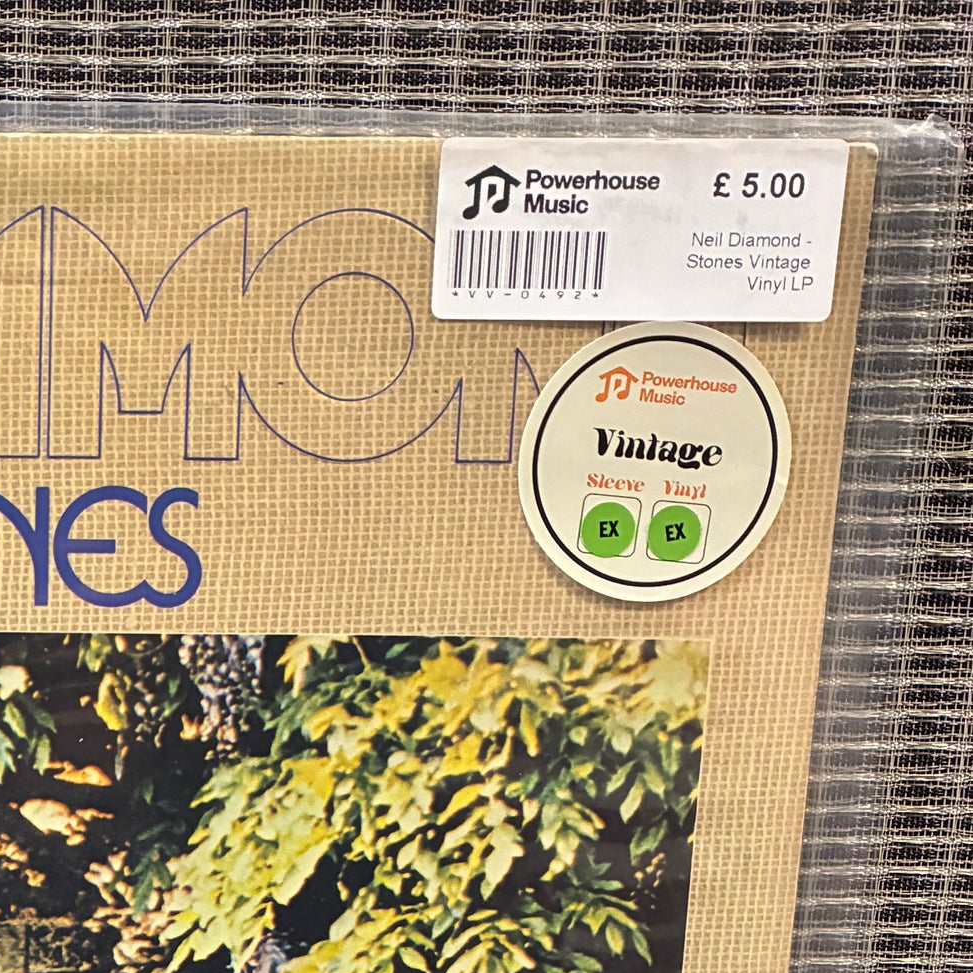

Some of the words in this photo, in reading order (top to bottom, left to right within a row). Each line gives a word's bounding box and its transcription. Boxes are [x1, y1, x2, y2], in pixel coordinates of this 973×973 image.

[525, 168, 661, 191] Powerhouse
[712, 172, 731, 199] £
[741, 172, 806, 199] 5.00
[523, 193, 589, 215] Music
[691, 231, 723, 247] Neil
[728, 231, 802, 248] Diamond
[686, 253, 743, 269] Stones
[749, 254, 811, 274] Vintage
[747, 275, 785, 295] Vinyl
[787, 276, 814, 292] LP
[641, 371, 738, 394] Powerhouse
[639, 388, 686, 406] Music
[593, 427, 723, 470] Vintage
[586, 473, 645, 492] Sleeve
[664, 480, 707, 500] Vinyl
[599, 520, 620, 538] EX
[665, 522, 686, 542] EX
